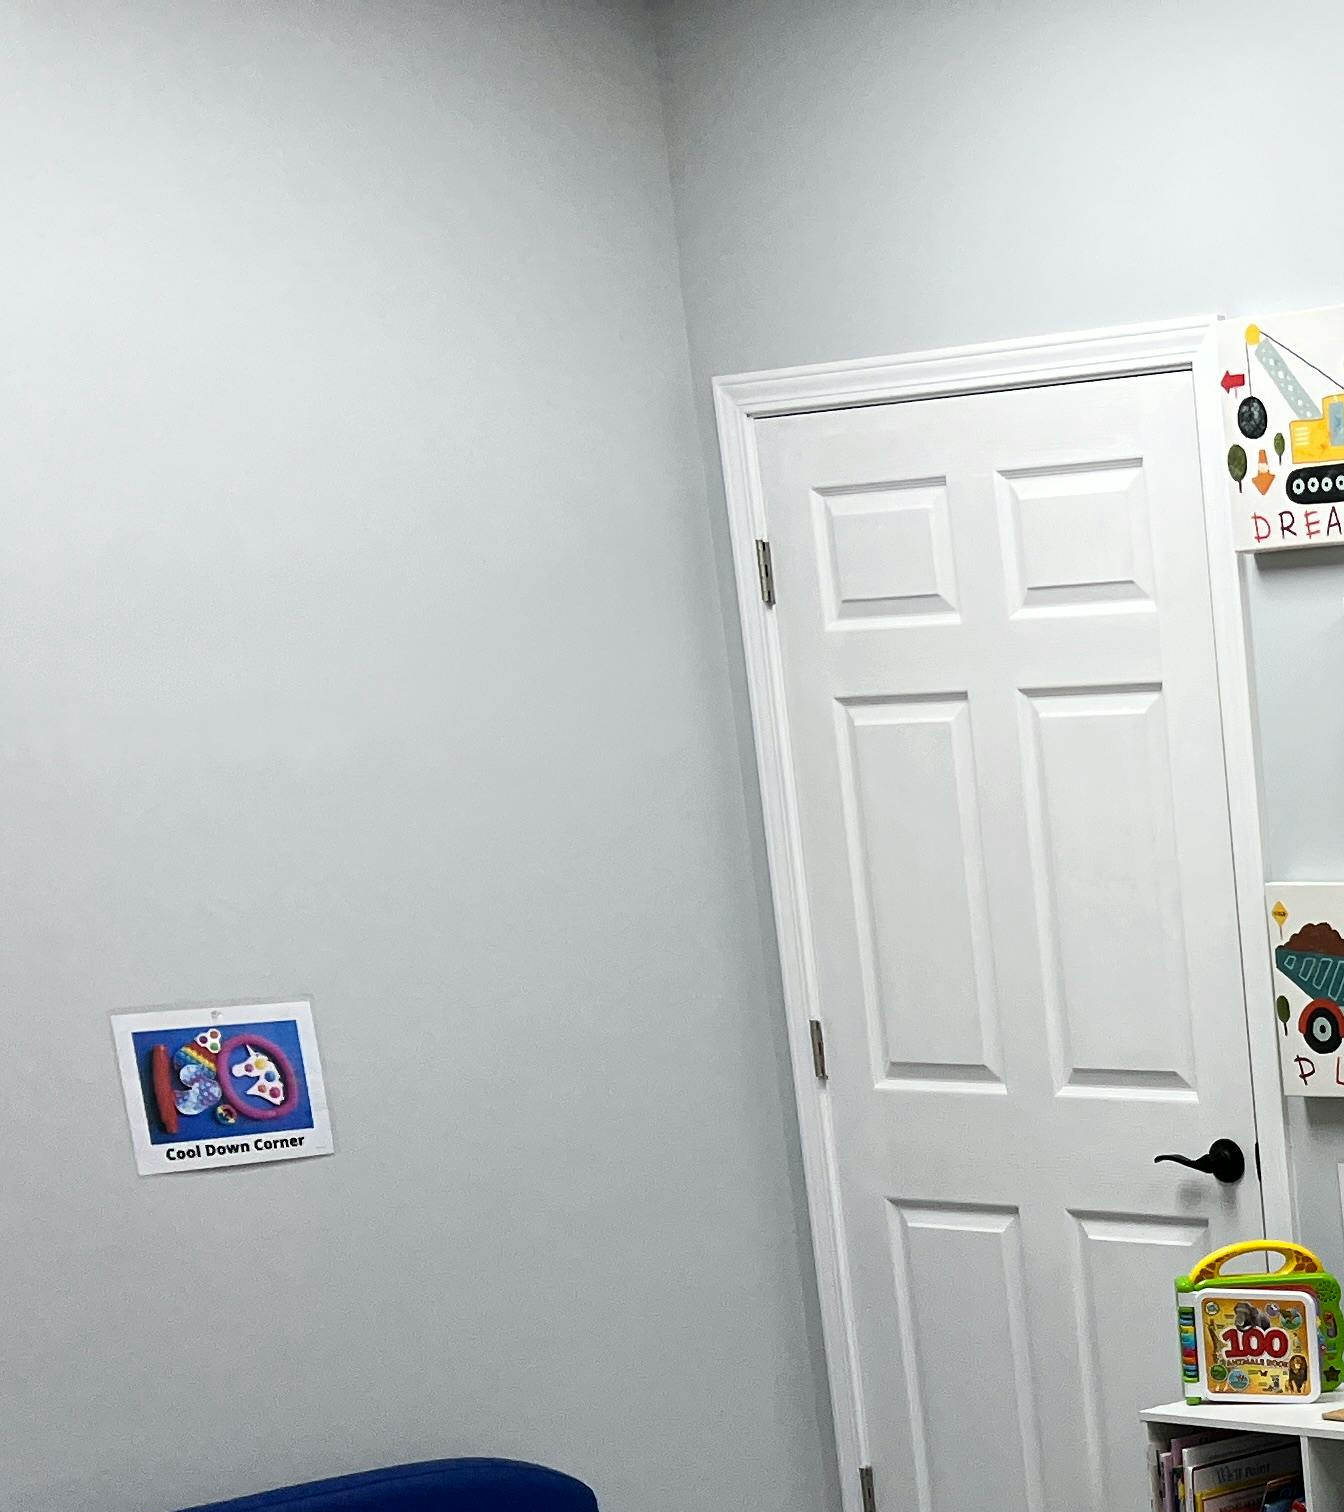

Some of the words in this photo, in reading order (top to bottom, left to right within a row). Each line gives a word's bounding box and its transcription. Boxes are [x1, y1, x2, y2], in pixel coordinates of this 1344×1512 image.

[166, 1145, 201, 1161] Cool
[205, 1141, 250, 1157] Down
[253, 1136, 305, 1151] Corner
[1222, 1328, 1289, 1359] 100
